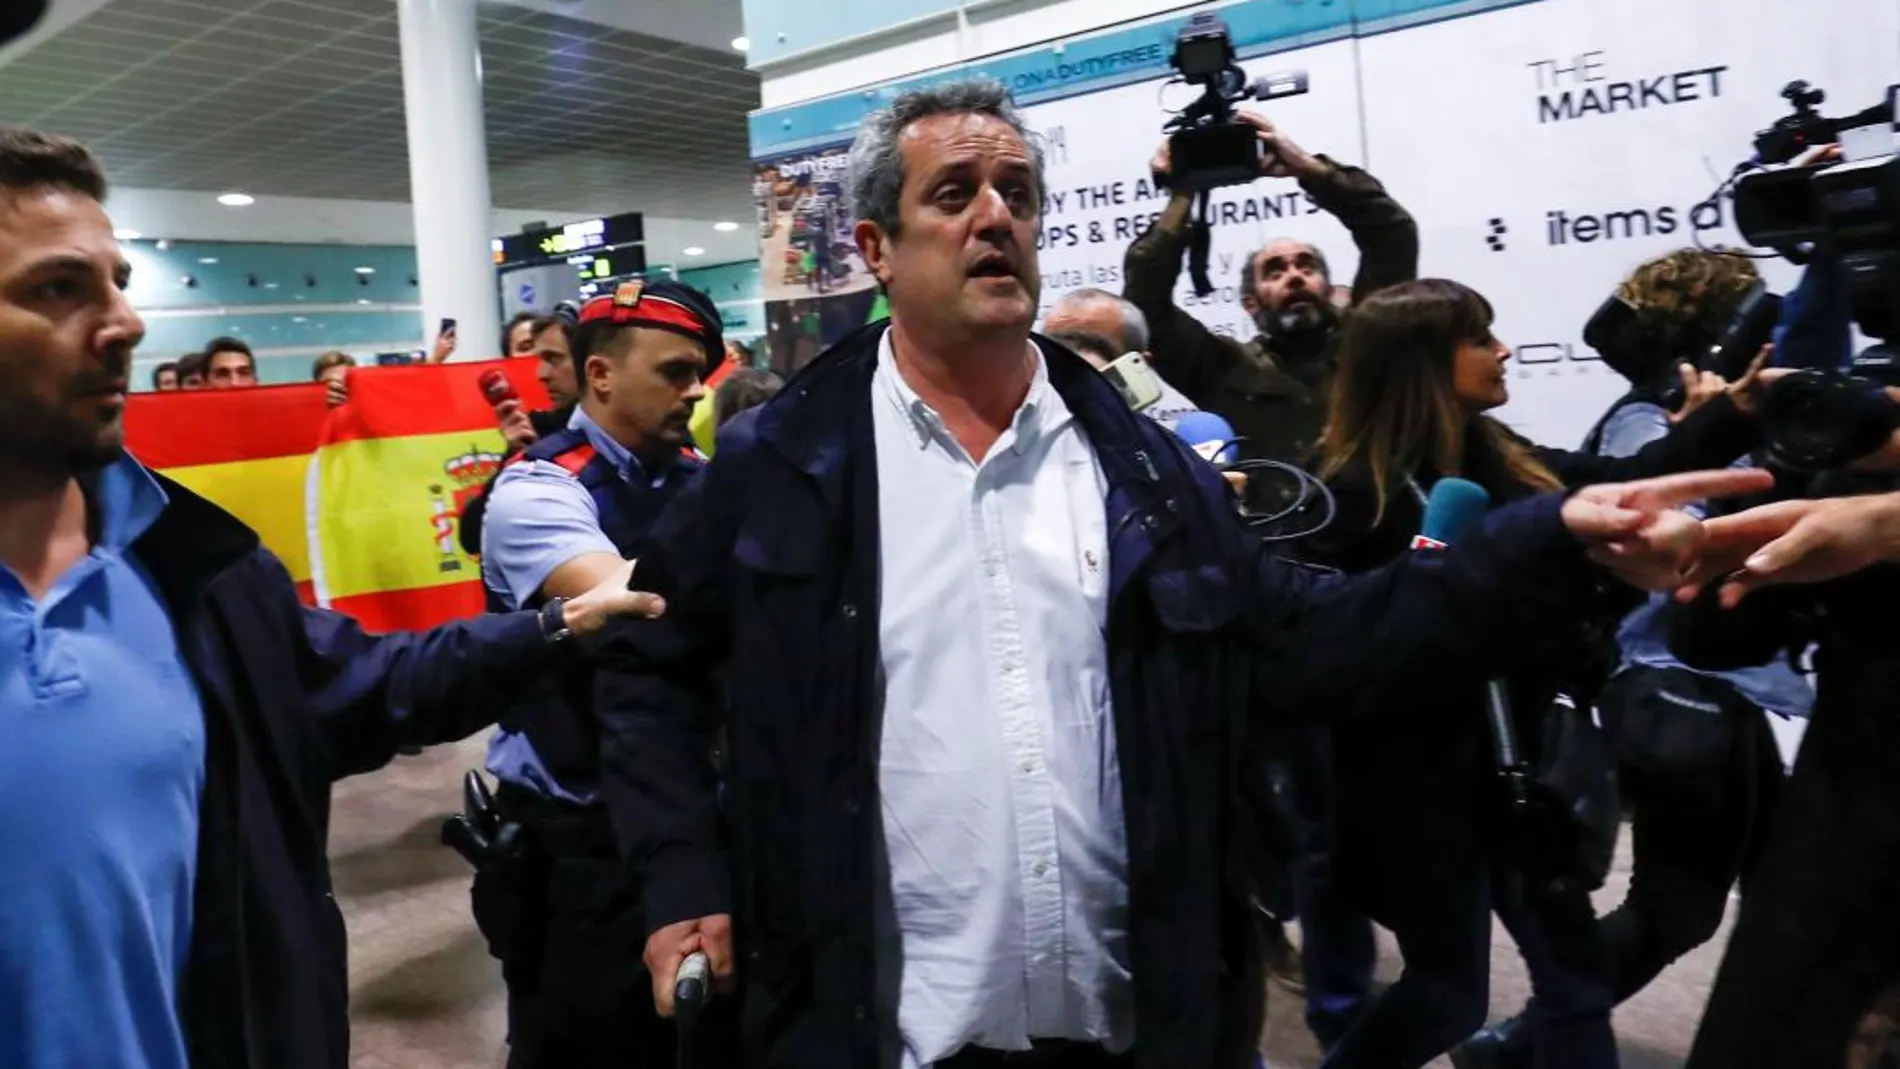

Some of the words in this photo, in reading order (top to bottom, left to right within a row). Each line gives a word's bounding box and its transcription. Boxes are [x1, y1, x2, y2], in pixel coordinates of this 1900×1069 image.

[1001, 43, 1161, 89] ONADUTYFREE
[1527, 50, 1604, 89] THE
[1538, 65, 1729, 123] MARKET
[1074, 181, 1125, 209] THE
[1088, 221, 1104, 243] &
[1547, 205, 1678, 246] items
